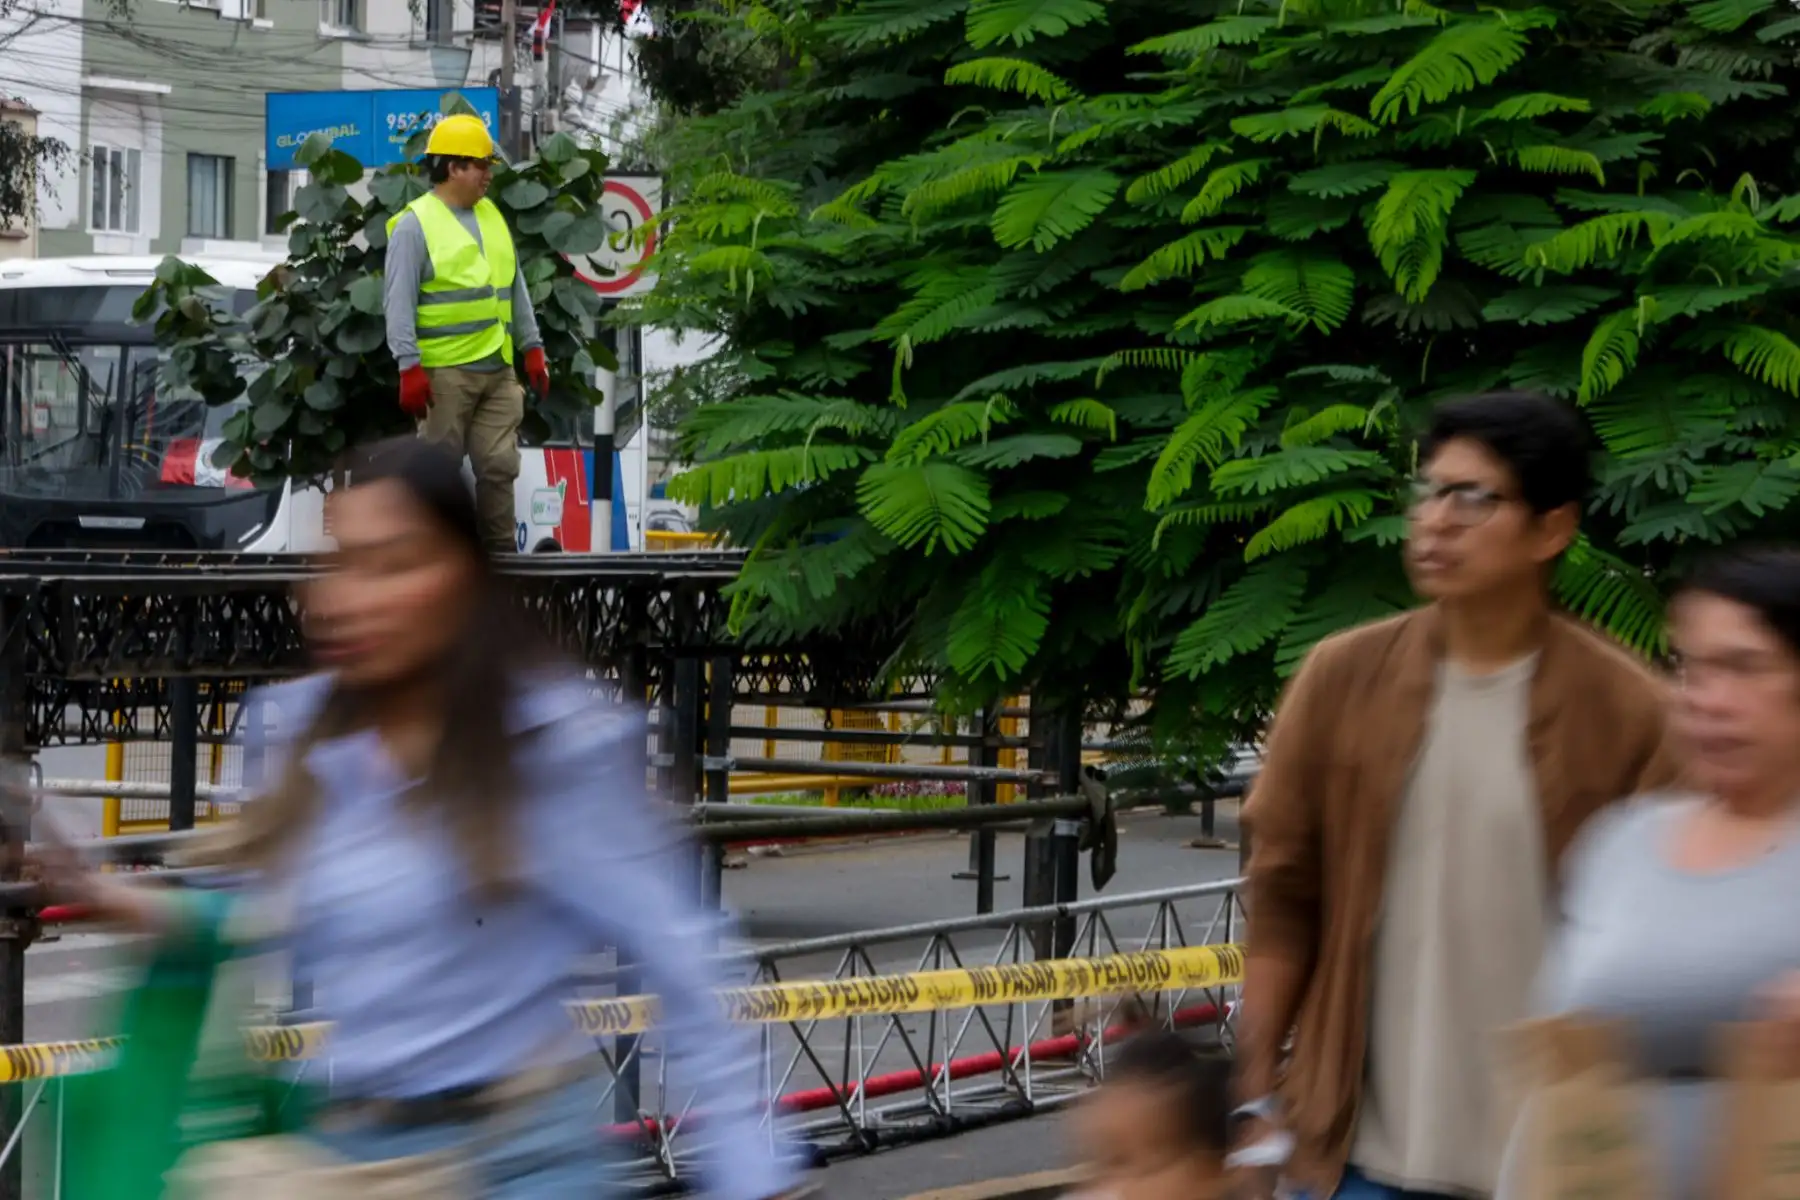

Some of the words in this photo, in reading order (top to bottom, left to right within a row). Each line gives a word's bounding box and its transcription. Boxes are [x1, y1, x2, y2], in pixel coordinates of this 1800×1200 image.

[825, 976, 919, 1008] PELIGRO
[966, 967, 998, 999] NO
[996, 963, 1058, 997] PASAR
[1090, 951, 1171, 985] PELIGRO
